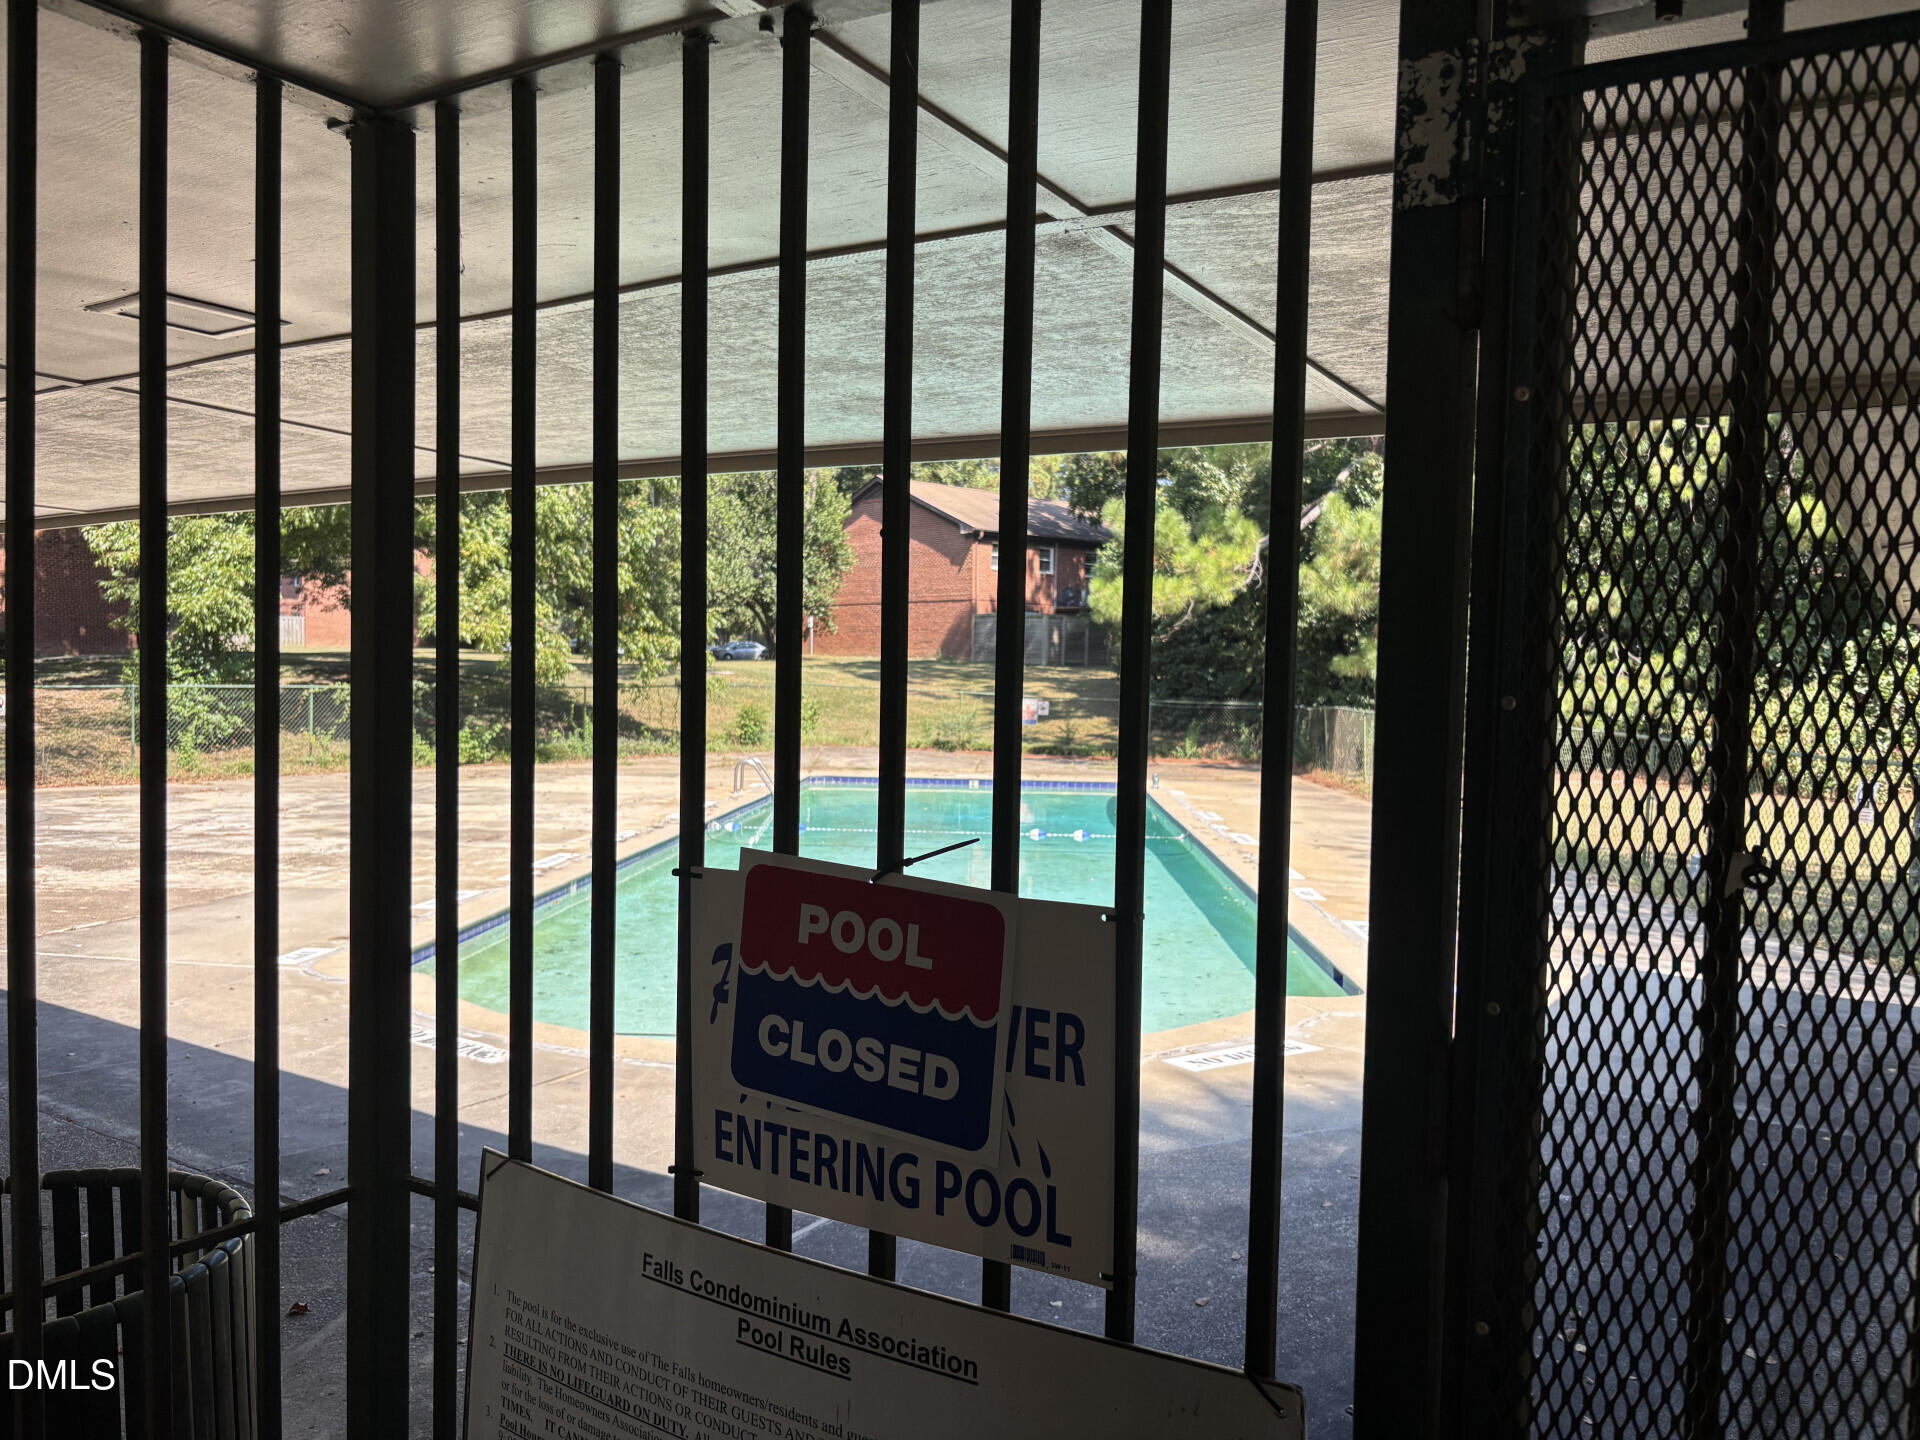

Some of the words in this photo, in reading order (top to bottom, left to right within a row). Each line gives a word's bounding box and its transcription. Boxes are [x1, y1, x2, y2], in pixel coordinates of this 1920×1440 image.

[797, 902, 933, 971] POOL
[758, 1013, 960, 1101] CLOSED
[714, 1109, 920, 1210] ENTERING
[935, 1160, 1072, 1248] POOL
[642, 1252, 684, 1285] Falls
[690, 1270, 831, 1335] Condominium
[837, 1318, 978, 1379] Association
[737, 1317, 783, 1352] Pool
[790, 1335, 851, 1374] Rules
[501, 1380, 510, 1391] or
[511, 1383, 524, 1399] for
[524, 1388, 537, 1405] the
[538, 1396, 554, 1414] loss
[556, 1407, 567, 1419] of
[566, 1413, 576, 1425] or
[503, 1342, 537, 1368] THERE
[538, 1359, 548, 1374] IS
[549, 1364, 565, 1381] NO
[567, 1373, 631, 1412] LIFEGUARD
[633, 1404, 651, 1421] ON
[653, 1412, 689, 1439] DUTY.
[503, 1359, 532, 1386] liability.
[537, 1377, 553, 1395] The
[555, 1385, 610, 1422] Homeowners
[505, 1307, 523, 1327] FOR
[525, 1317, 543, 1335] ALL
[545, 1327, 588, 1356] ACTIONS
[590, 1347, 613, 1366] AND
[615, 1358, 671, 1391] CONDUCT
[673, 1382, 689, 1399] OF
[691, 1389, 728, 1415] THEIR
[731, 1406, 782, 1436] GUESTS
[505, 1324, 556, 1360] RESULTING
[558, 1350, 587, 1373] FROM
[589, 1364, 621, 1390] THEIR
[622, 1381, 672, 1412] ACTIONS
[675, 1403, 692, 1421] OR
[507, 1289, 521, 1306] The
[523, 1300, 540, 1315] pool
[542, 1305, 549, 1319] is
[551, 1310, 562, 1325] for
[564, 1316, 577, 1332] the
[579, 1326, 619, 1351] exclusive
[621, 1344, 637, 1358] use
[639, 1350, 651, 1364] of
[651, 1353, 670, 1372] The
[672, 1362, 696, 1383] Falls
[698, 1371, 818, 1429] homeowners/residents
[822, 1422, 843, 1438] and
[500, 1395, 534, 1422] TIMES.
[545, 1418, 556, 1433] IT
[500, 1413, 517, 1432] Pool
